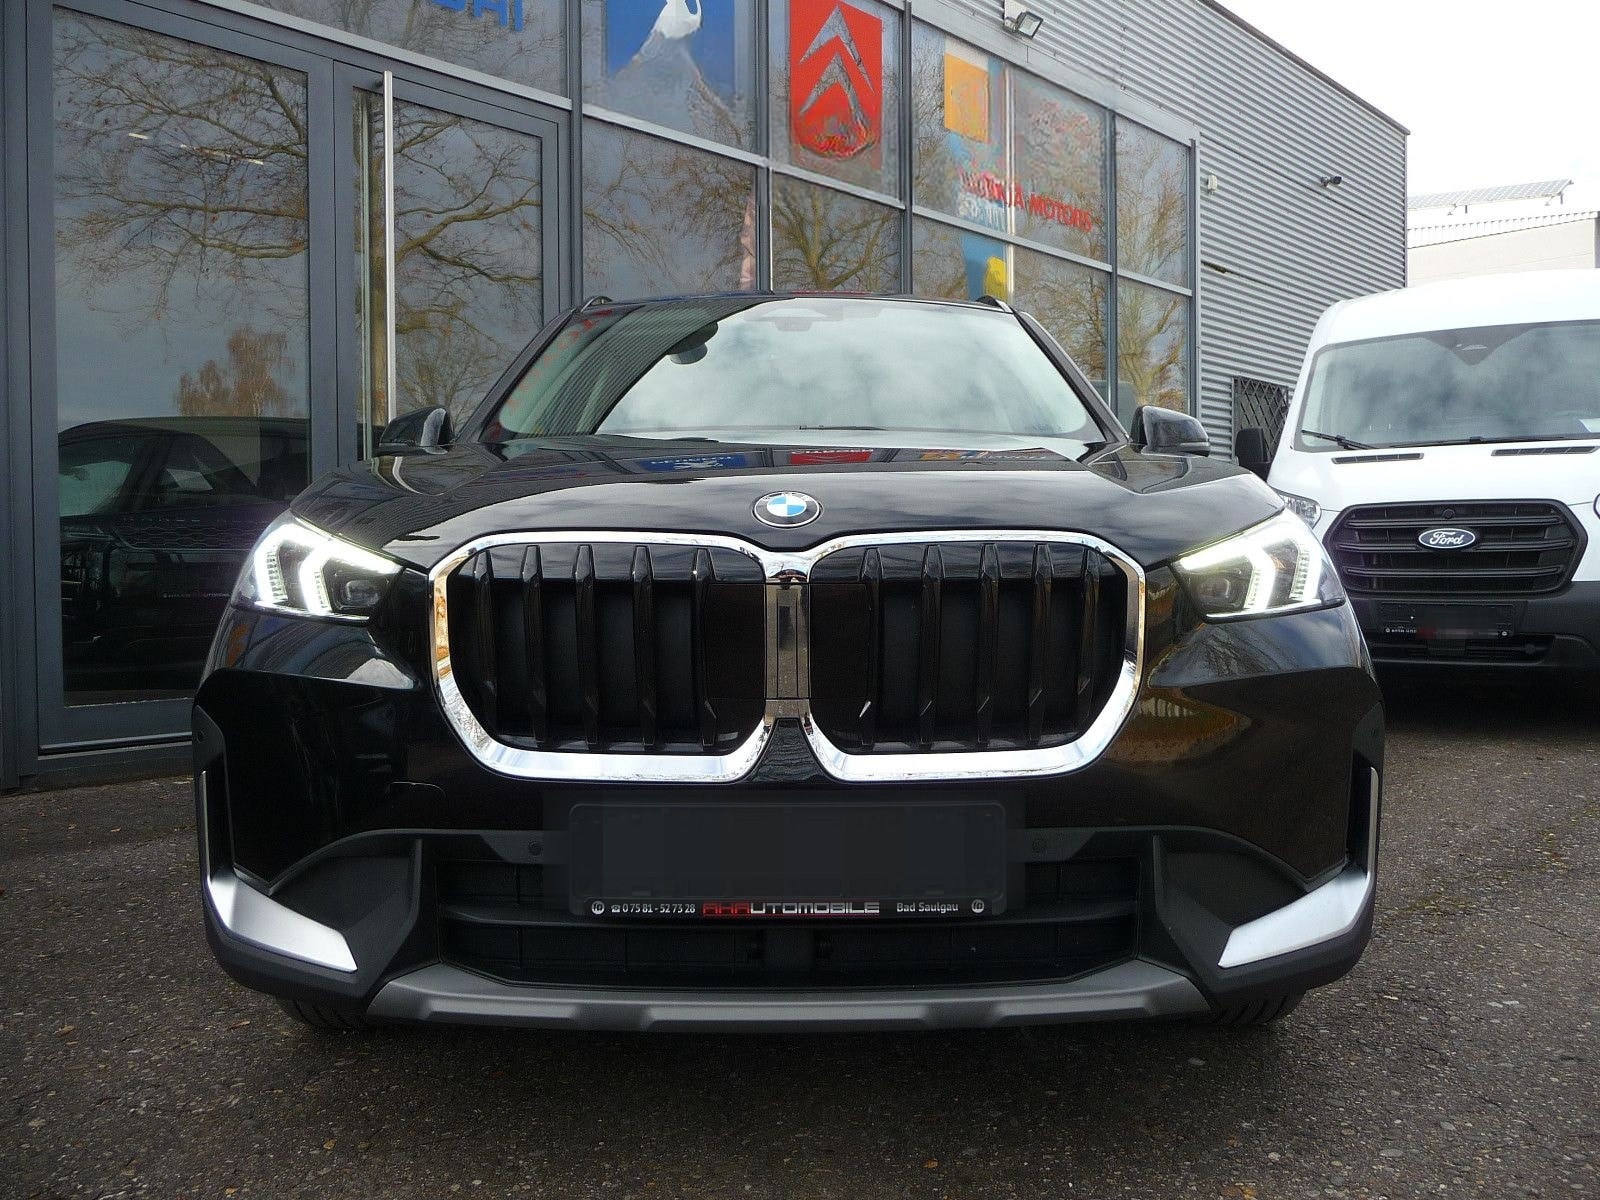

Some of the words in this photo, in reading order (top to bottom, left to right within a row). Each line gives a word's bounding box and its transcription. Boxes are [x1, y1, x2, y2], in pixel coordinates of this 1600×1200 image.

[1430, 531, 1464, 545] Ford
[896, 902, 916, 913] Bad
[918, 902, 959, 914] Saulgau
